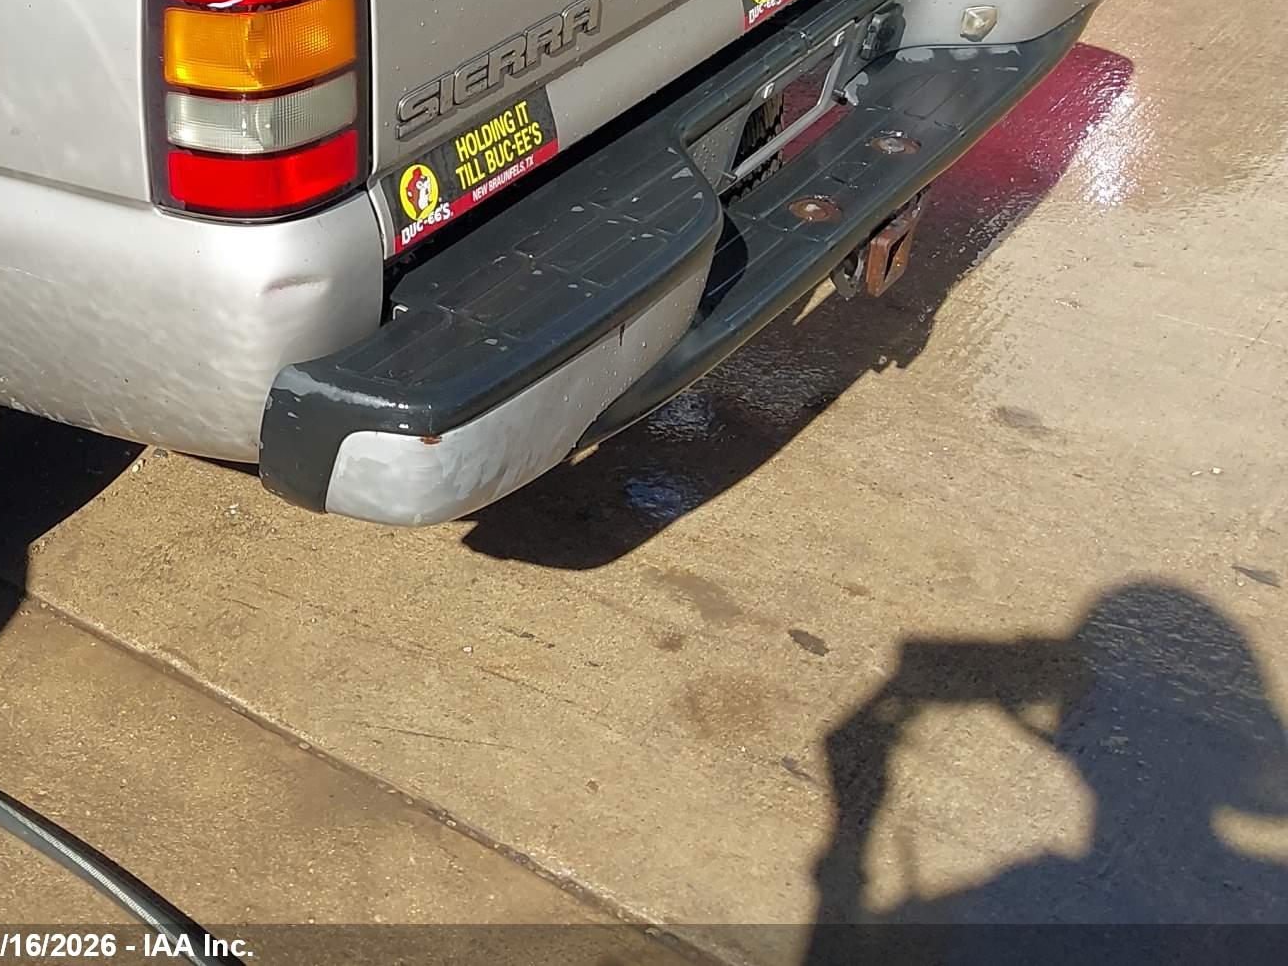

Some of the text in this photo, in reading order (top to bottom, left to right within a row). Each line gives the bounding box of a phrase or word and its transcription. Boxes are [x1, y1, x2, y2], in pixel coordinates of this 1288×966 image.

[455, 101, 529, 162] HOLDING IT
[455, 122, 542, 190] TILL BUC-EE'S
[472, 184, 488, 202] NEW
[524, 154, 534, 169] TX
